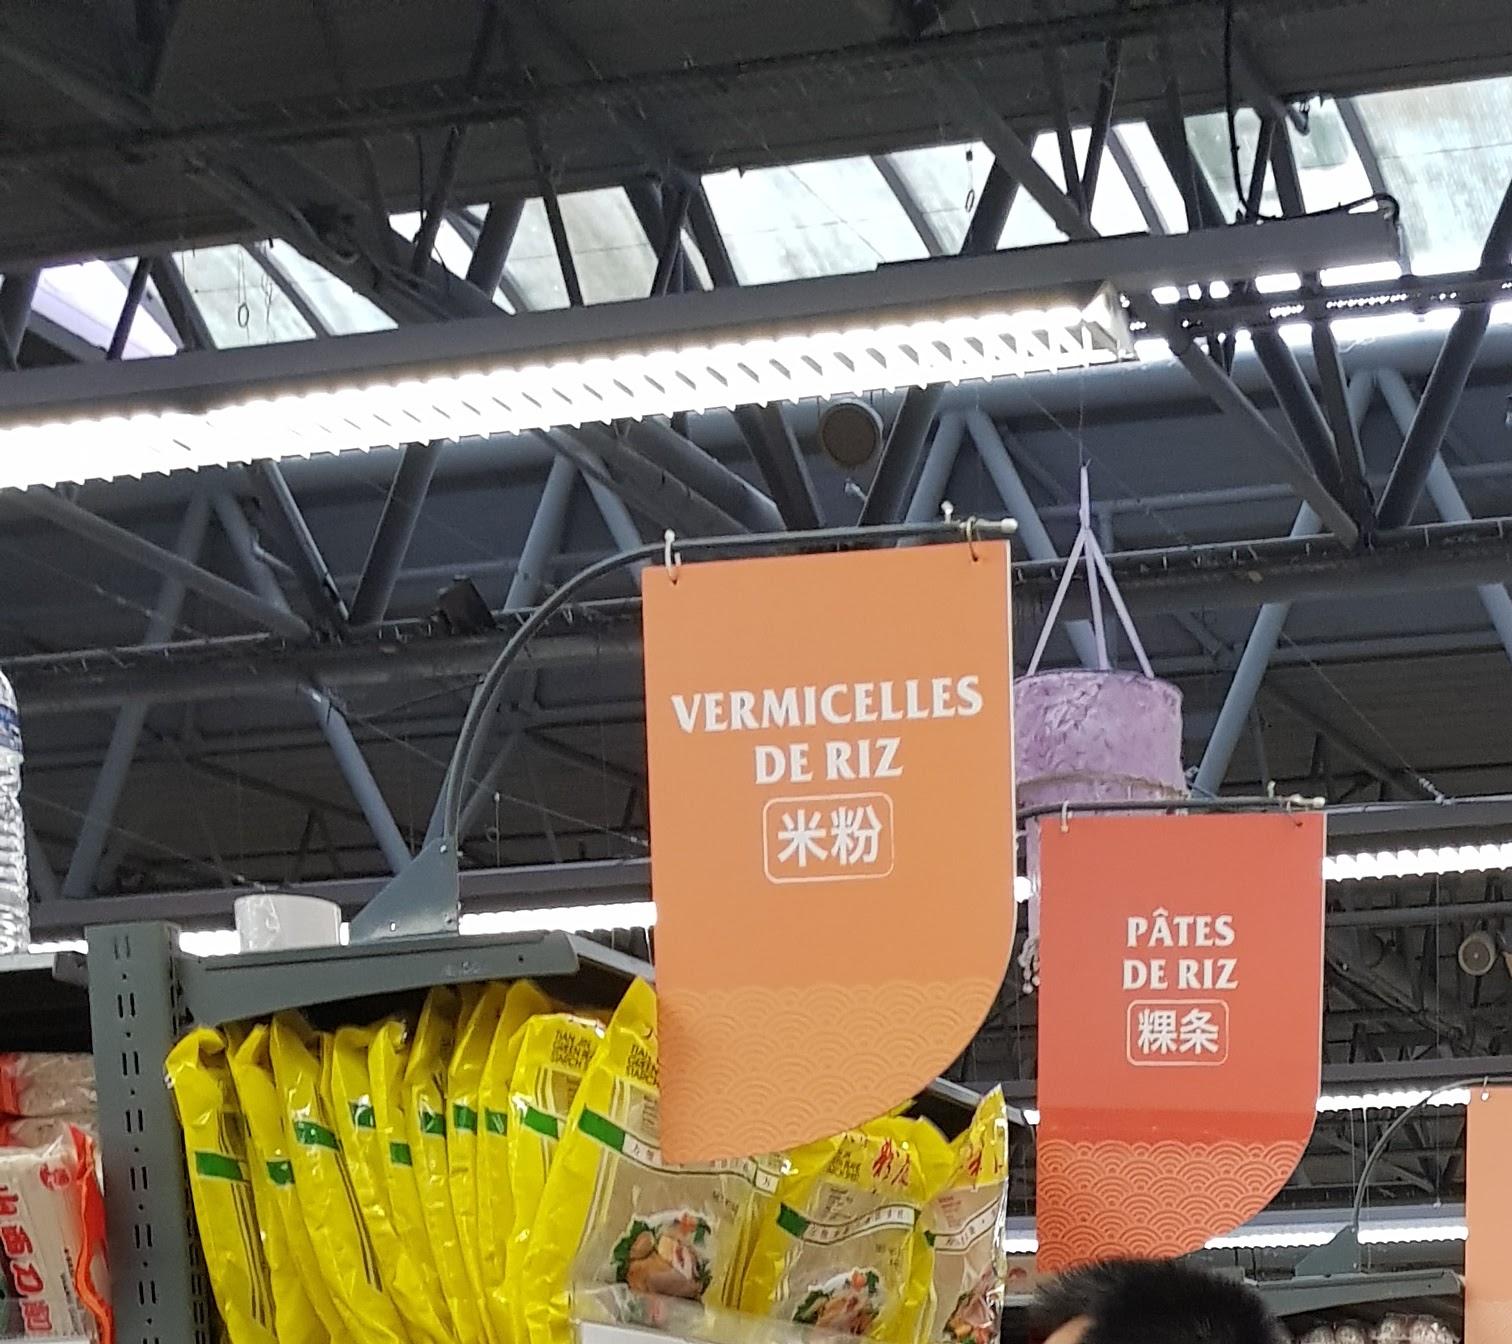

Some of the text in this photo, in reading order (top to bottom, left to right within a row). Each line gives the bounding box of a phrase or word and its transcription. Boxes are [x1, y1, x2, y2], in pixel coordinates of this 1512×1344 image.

[671, 676, 983, 735] VERMICELLES
[754, 736, 904, 785] DE RIZ
[777, 804, 884, 868] 米粉
[1126, 908, 1236, 948] PÂTES
[1122, 956, 1238, 990] DE RIZ
[1137, 1007, 1220, 1056] 粿条
